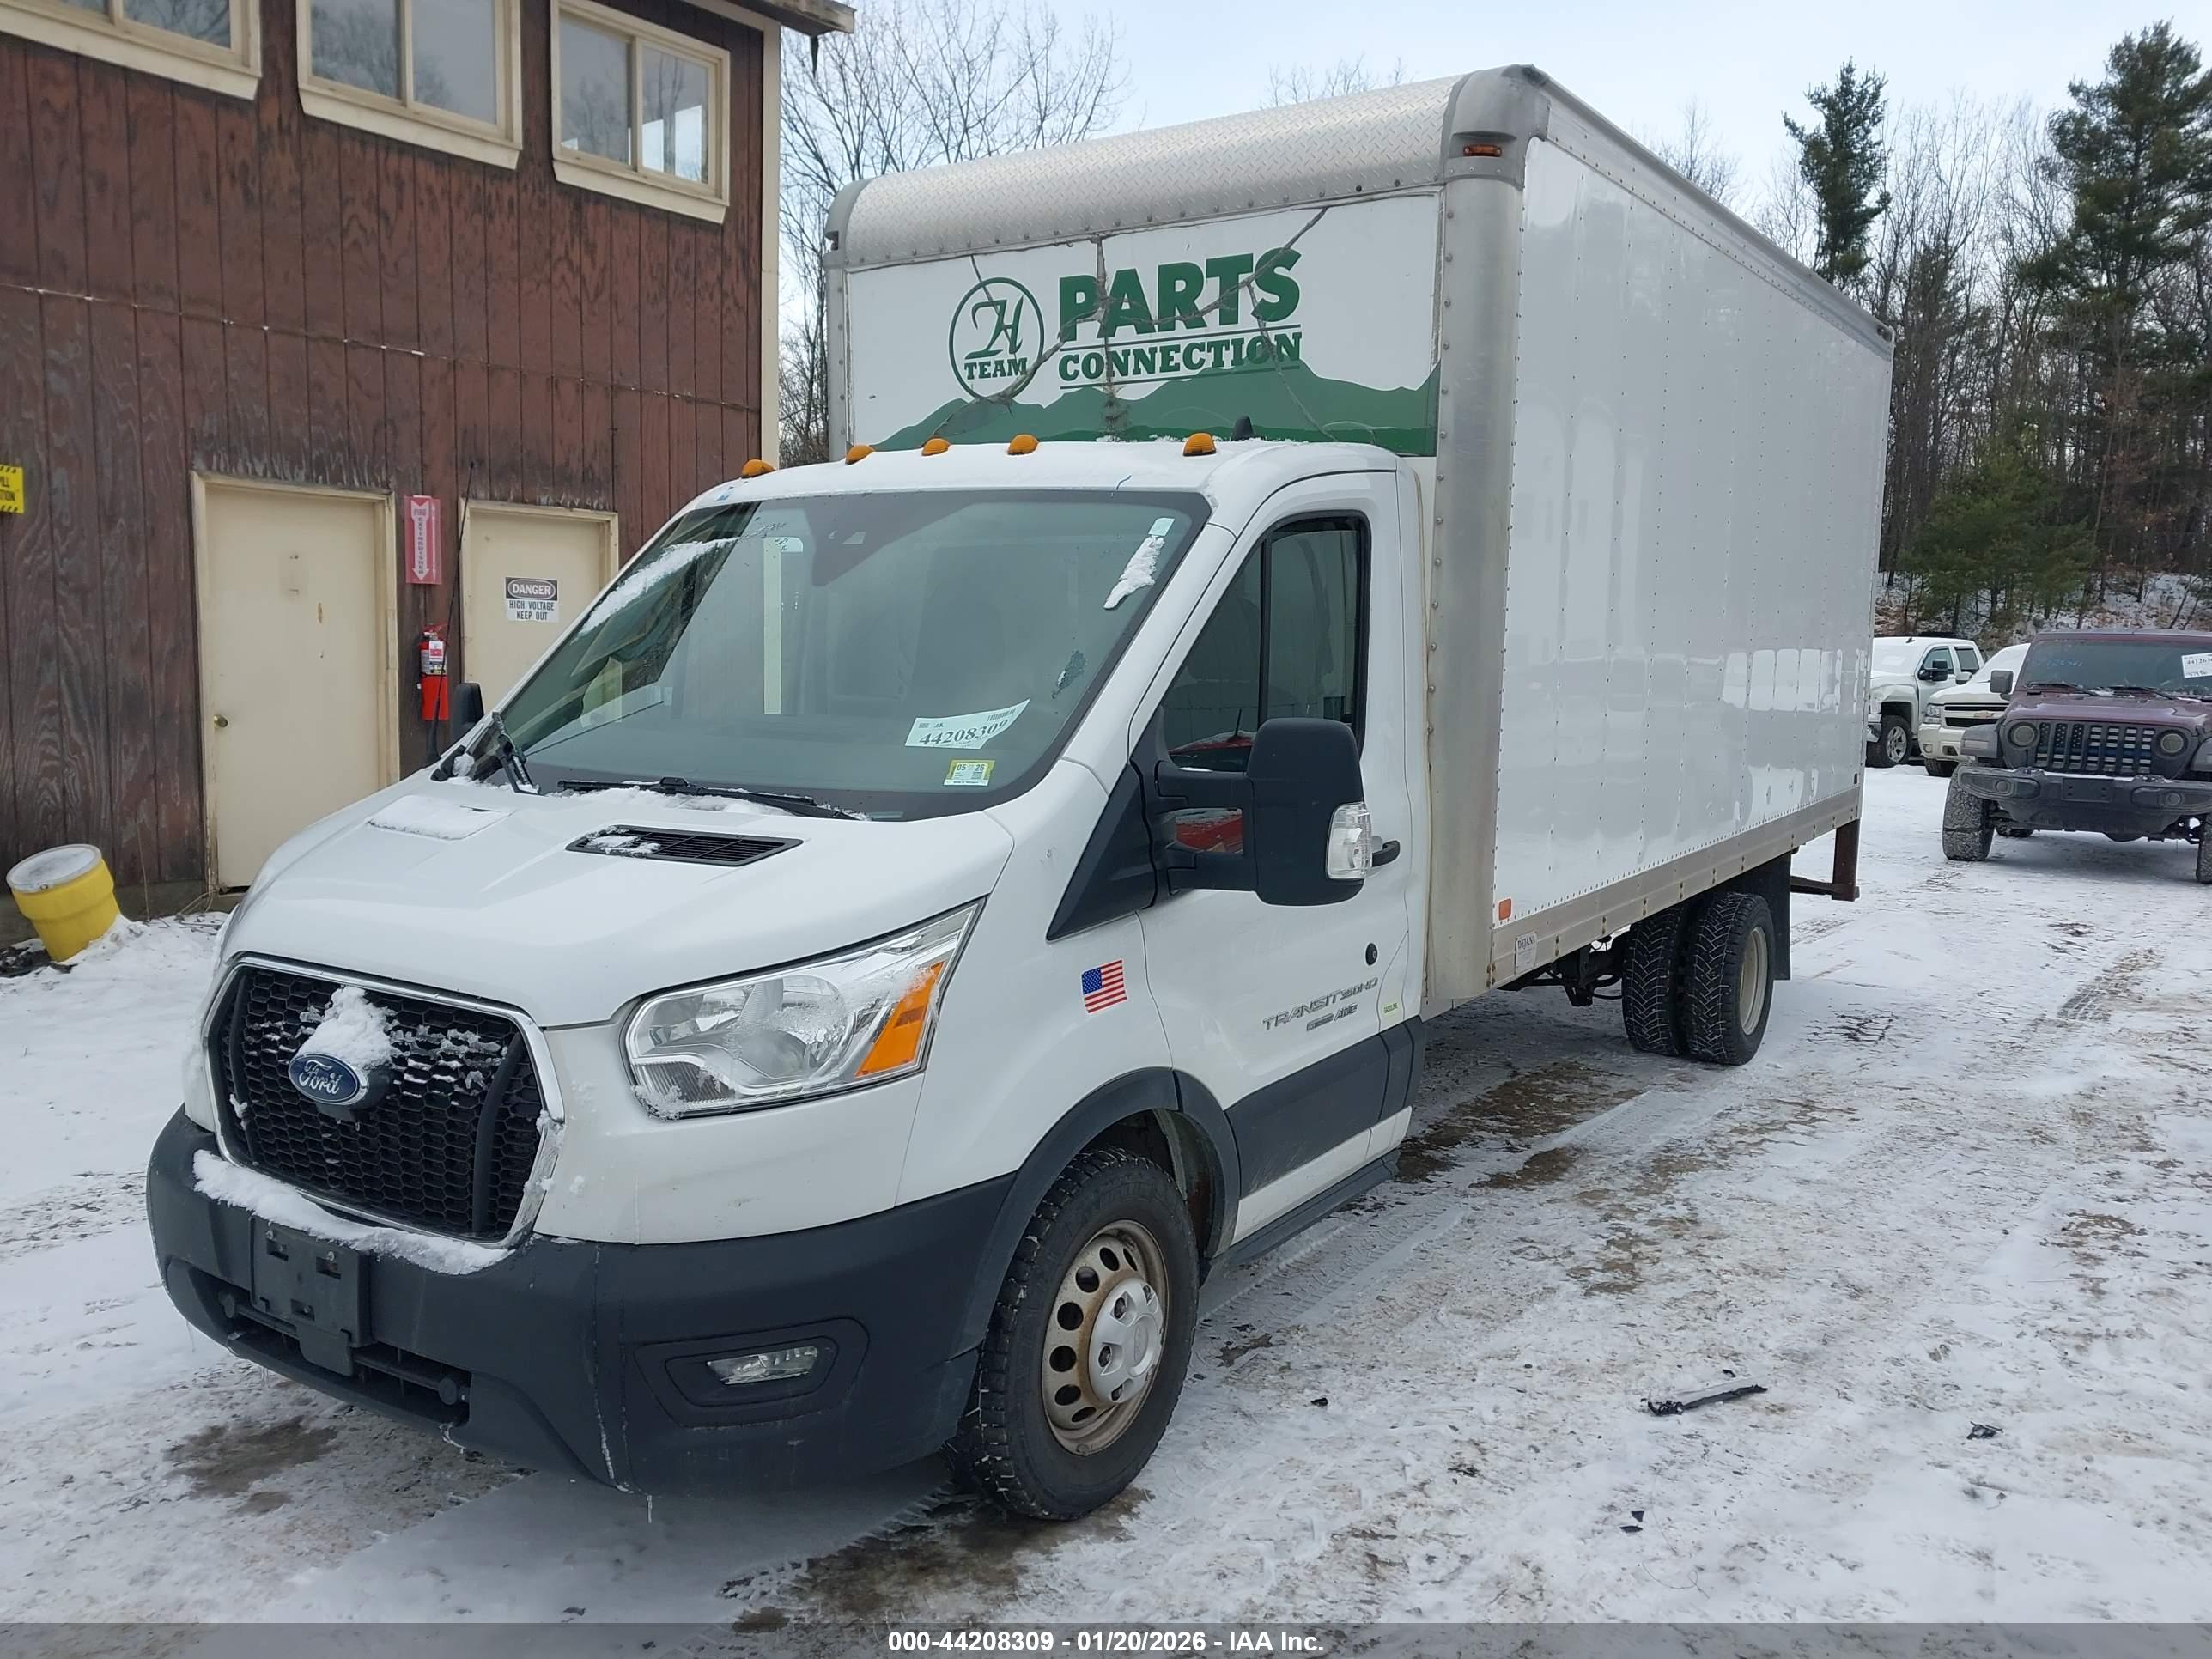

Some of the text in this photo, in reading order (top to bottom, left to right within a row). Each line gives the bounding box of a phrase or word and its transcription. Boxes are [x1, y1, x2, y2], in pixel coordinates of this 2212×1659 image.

[1058, 247, 1302, 342] PARTS
[963, 356, 1027, 380] TEAM
[1058, 331, 1302, 381] CONNECTION
[513, 583, 551, 595] DANGER
[509, 599, 555, 611] HIGH VOLTAGE
[517, 611, 548, 621] KEEP OUT
[919, 719, 1009, 744] 44208309
[1262, 990, 1342, 1030] TRANSIT
[298, 1059, 343, 1095] Ford
